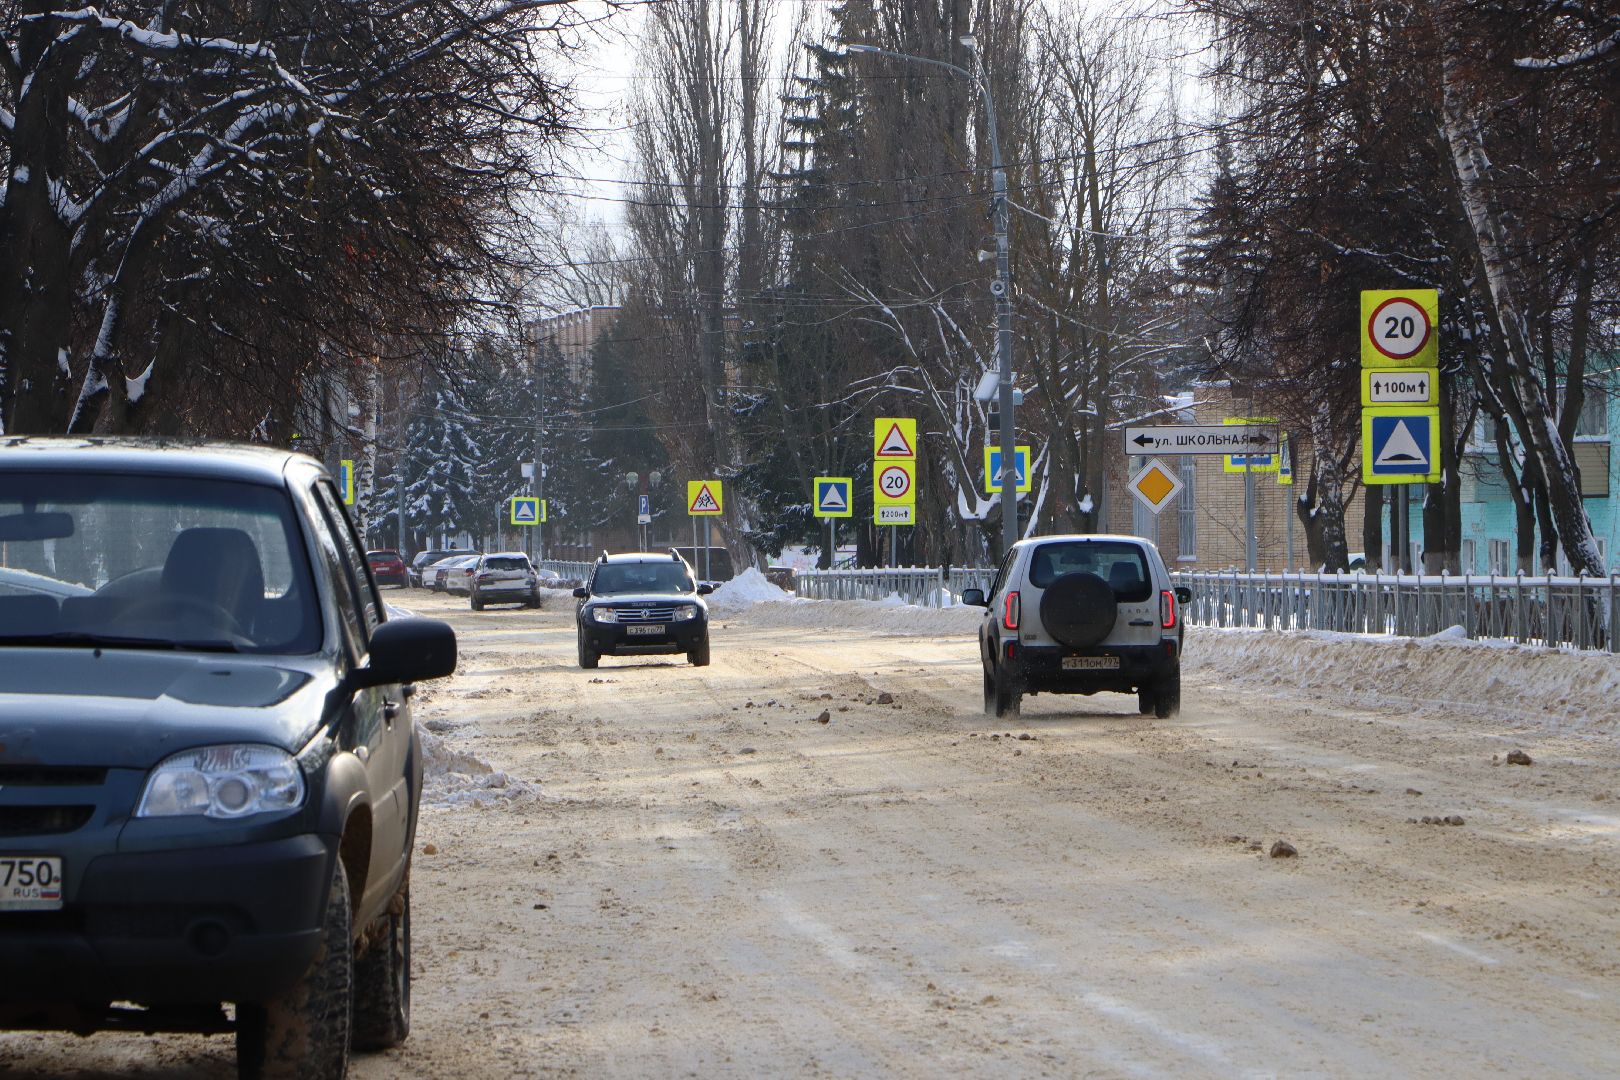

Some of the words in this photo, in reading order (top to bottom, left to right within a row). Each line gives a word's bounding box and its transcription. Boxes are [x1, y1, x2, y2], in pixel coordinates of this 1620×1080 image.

[1384, 316, 1414, 339] 20
[1384, 382, 1416, 393] 100м
[1154, 437, 1172, 449] ул.
[1176, 434, 1249, 446] ШКОЛЬНАЯ
[886, 476, 904, 489] 20
[0, 860, 53, 887] 750
[13, 887, 39, 898] RUS
